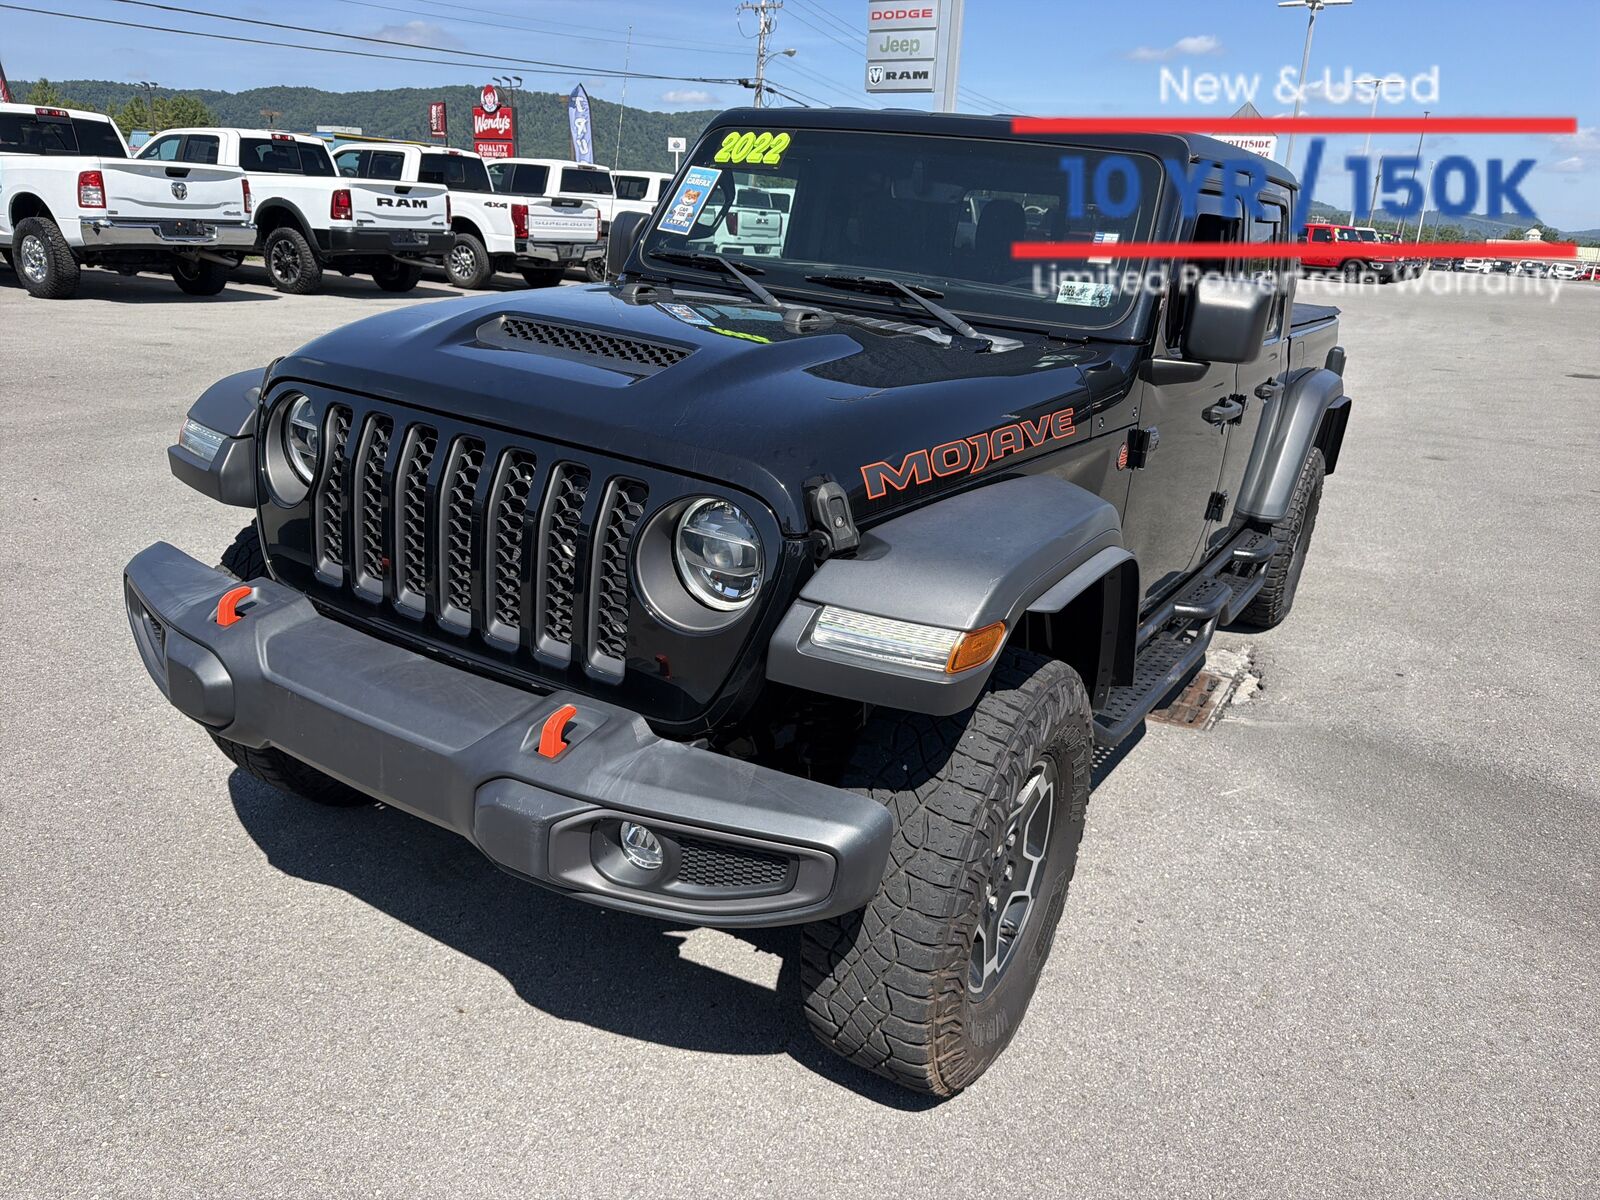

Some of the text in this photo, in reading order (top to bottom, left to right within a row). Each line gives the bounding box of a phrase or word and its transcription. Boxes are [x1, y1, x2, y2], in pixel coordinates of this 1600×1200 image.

[871, 9, 933, 20] DODGE
[879, 35, 921, 56] Jeep
[885, 71, 929, 80] RAM
[474, 112, 511, 135] Wendy's
[478, 144, 508, 152] QUALITY
[714, 131, 791, 164] 2022
[686, 177, 712, 188] CARFAX
[376, 198, 428, 208] RAM
[860, 407, 1076, 499] MOJAVE
